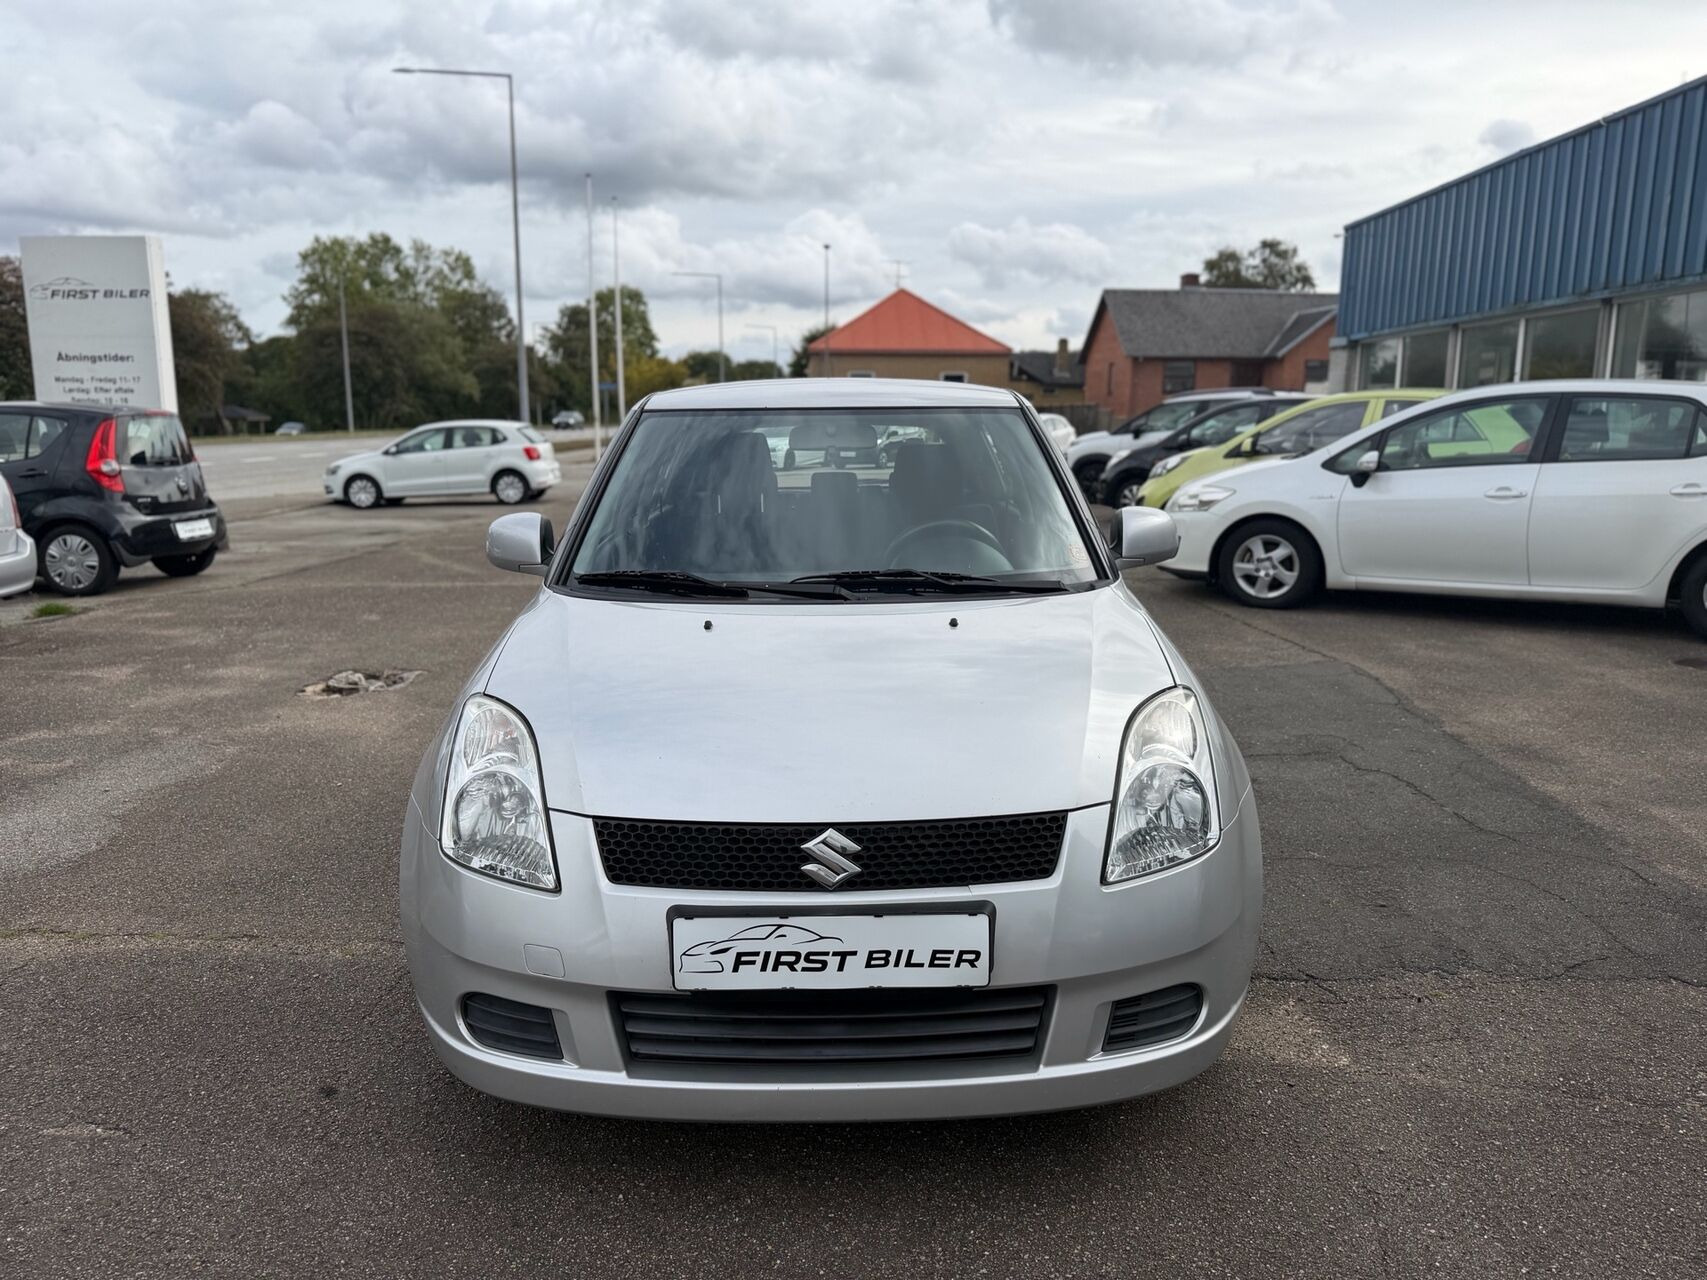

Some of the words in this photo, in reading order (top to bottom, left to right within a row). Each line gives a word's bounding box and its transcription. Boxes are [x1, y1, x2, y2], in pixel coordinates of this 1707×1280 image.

[50, 289, 100, 300] FIRST
[102, 288, 150, 299] BILER
[56, 351, 134, 364] Åbningstider:
[54, 376, 84, 385] Mandag
[90, 376, 117, 385] Fredag
[731, 950, 858, 973] FIRST
[864, 949, 982, 969] BILER
